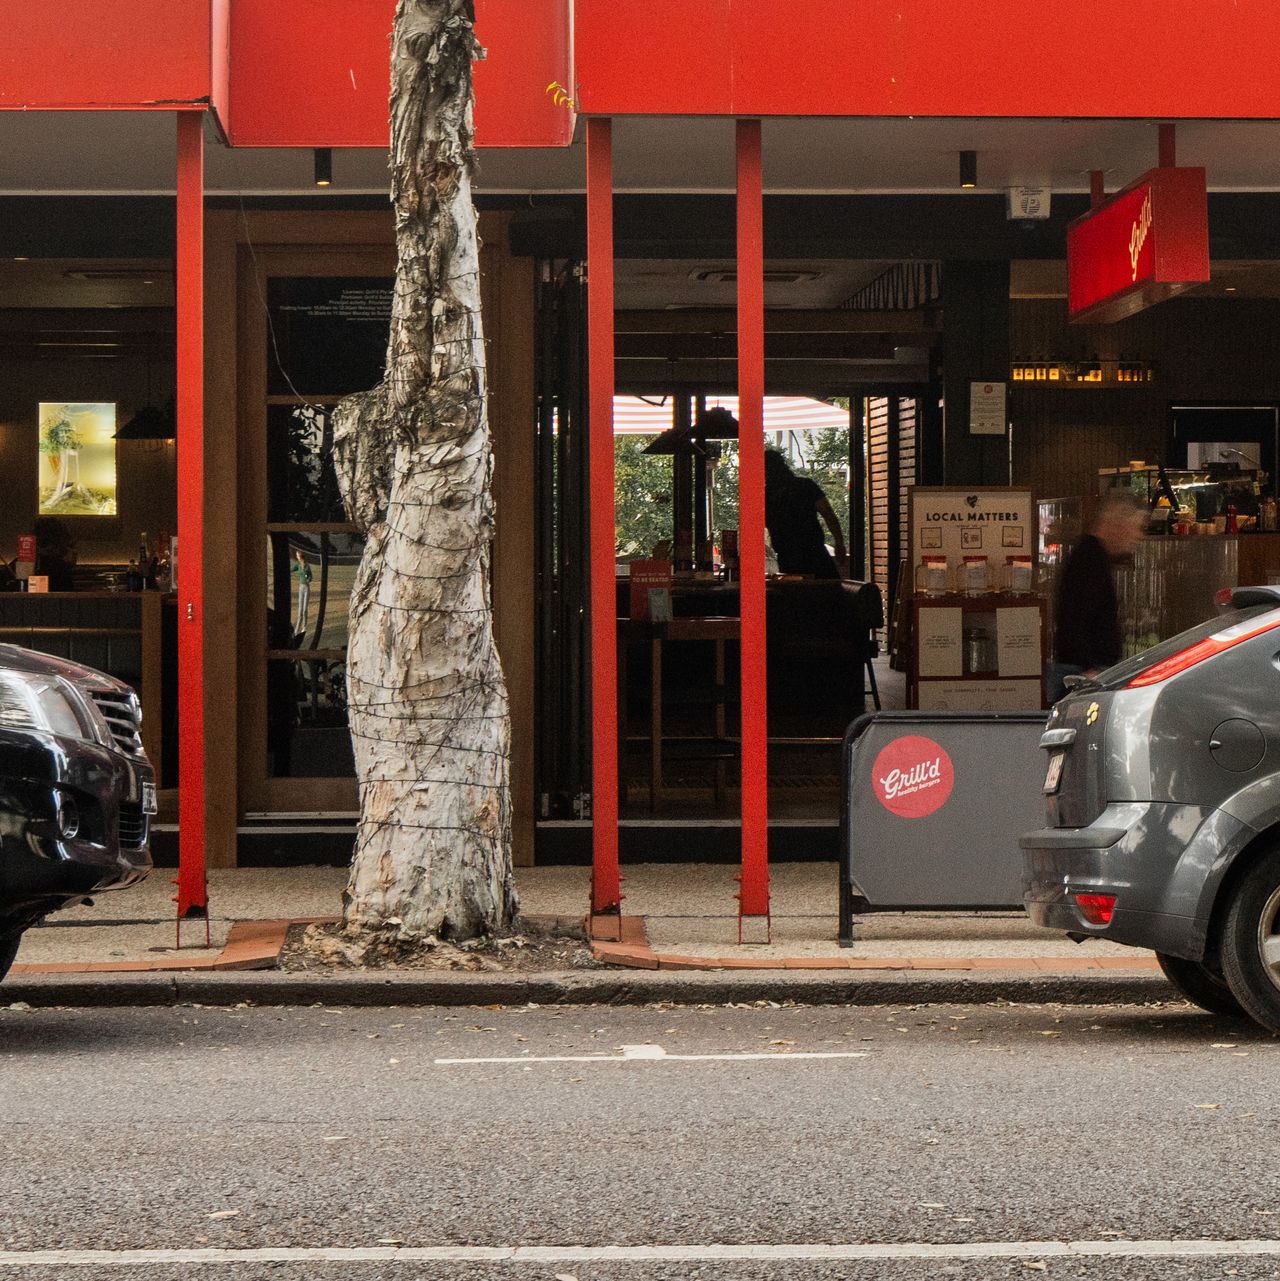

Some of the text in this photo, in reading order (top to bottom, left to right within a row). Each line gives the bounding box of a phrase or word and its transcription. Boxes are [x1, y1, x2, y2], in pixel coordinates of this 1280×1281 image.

[1129, 186, 1152, 281] Grill'd
[926, 512, 1018, 521] LOCAL MATTERS
[880, 757, 940, 799] Grill'd
